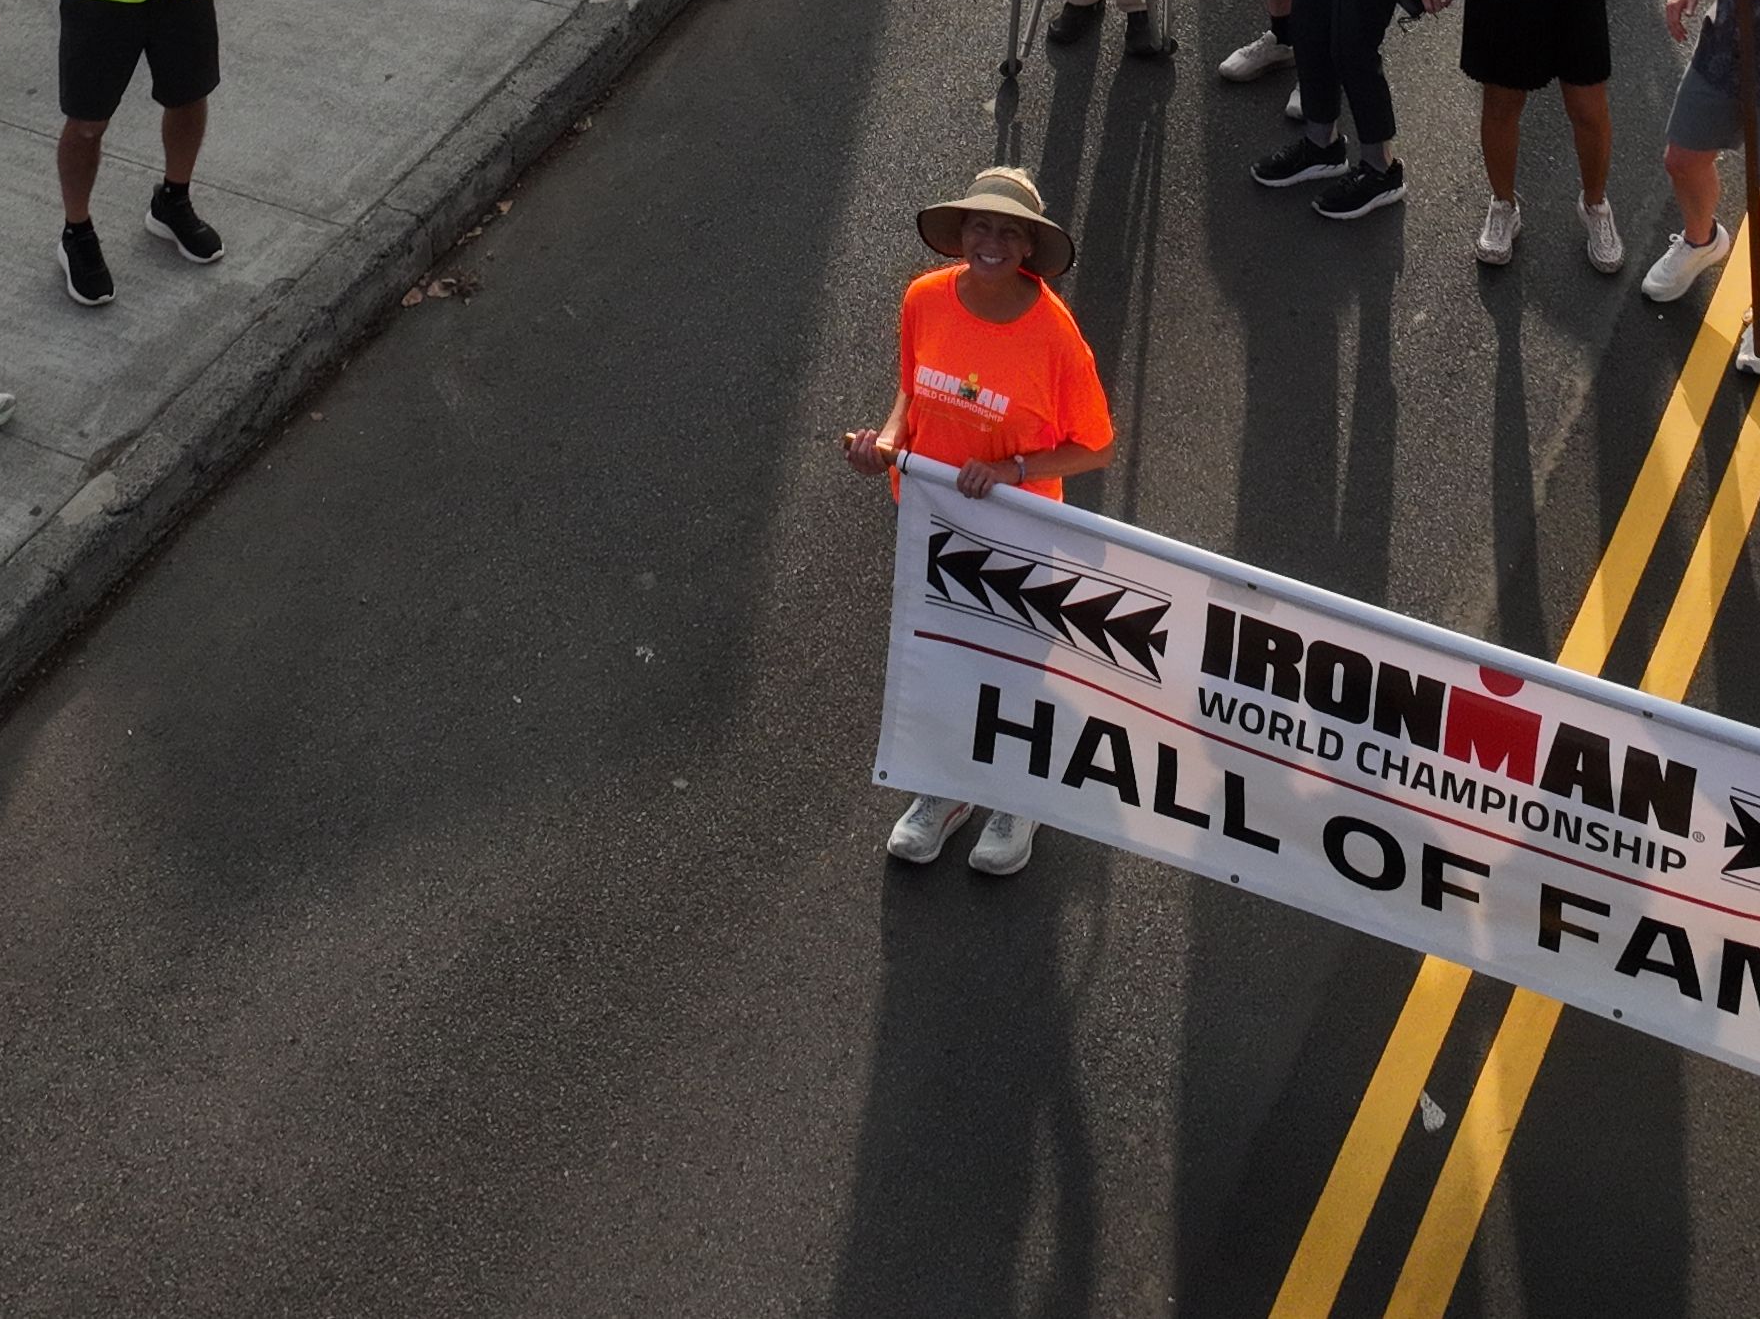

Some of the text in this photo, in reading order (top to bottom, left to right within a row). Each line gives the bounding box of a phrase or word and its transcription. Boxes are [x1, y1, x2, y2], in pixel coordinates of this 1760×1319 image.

[938, 393, 1004, 423] CHAMPIONSHIP
[972, 682, 1280, 854] HALL
[1322, 813, 1491, 912] OF
[1197, 687, 1689, 875] WORLD CHAMPIONSHIP
[1202, 604, 1699, 840] IRONMAN
